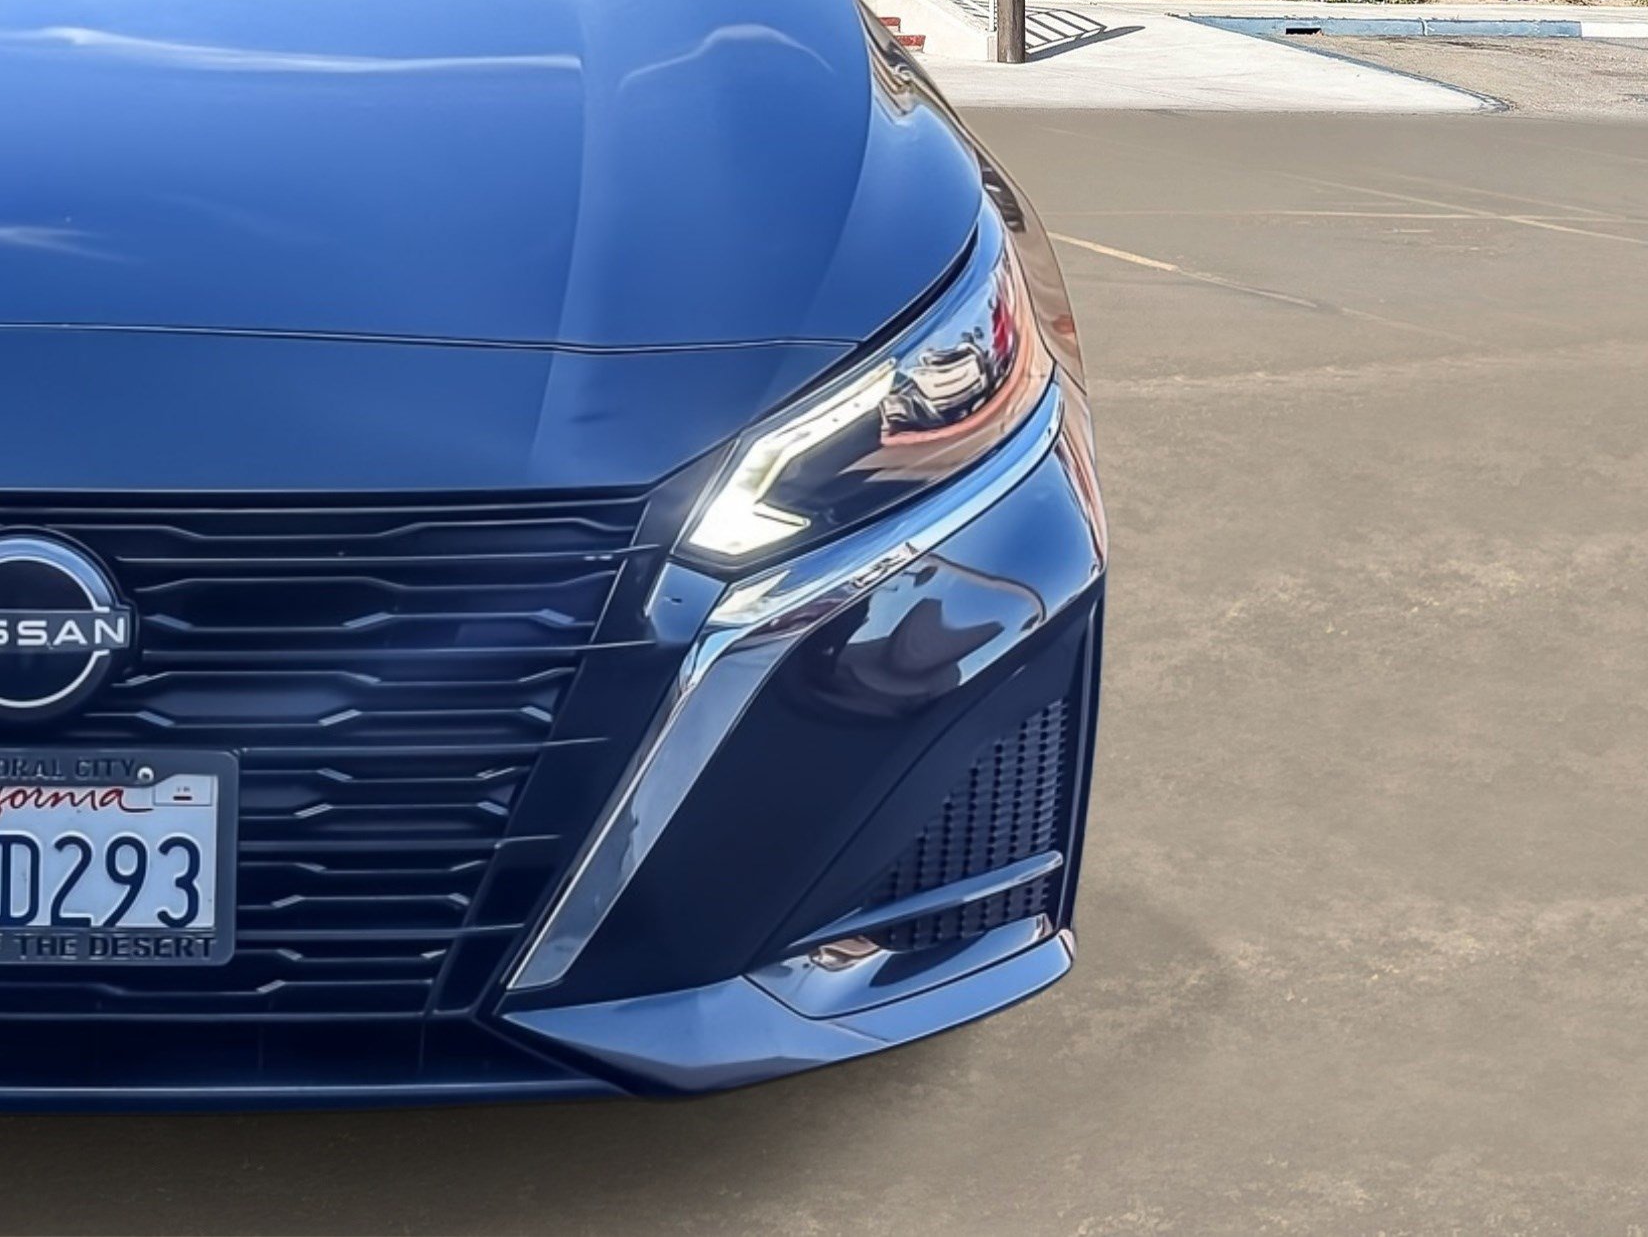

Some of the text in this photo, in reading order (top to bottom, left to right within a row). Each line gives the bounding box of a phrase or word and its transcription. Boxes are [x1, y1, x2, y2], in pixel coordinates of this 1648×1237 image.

[74, 756, 138, 779] CITY
[15, 933, 79, 959] THE
[89, 933, 217, 959] DESERT
